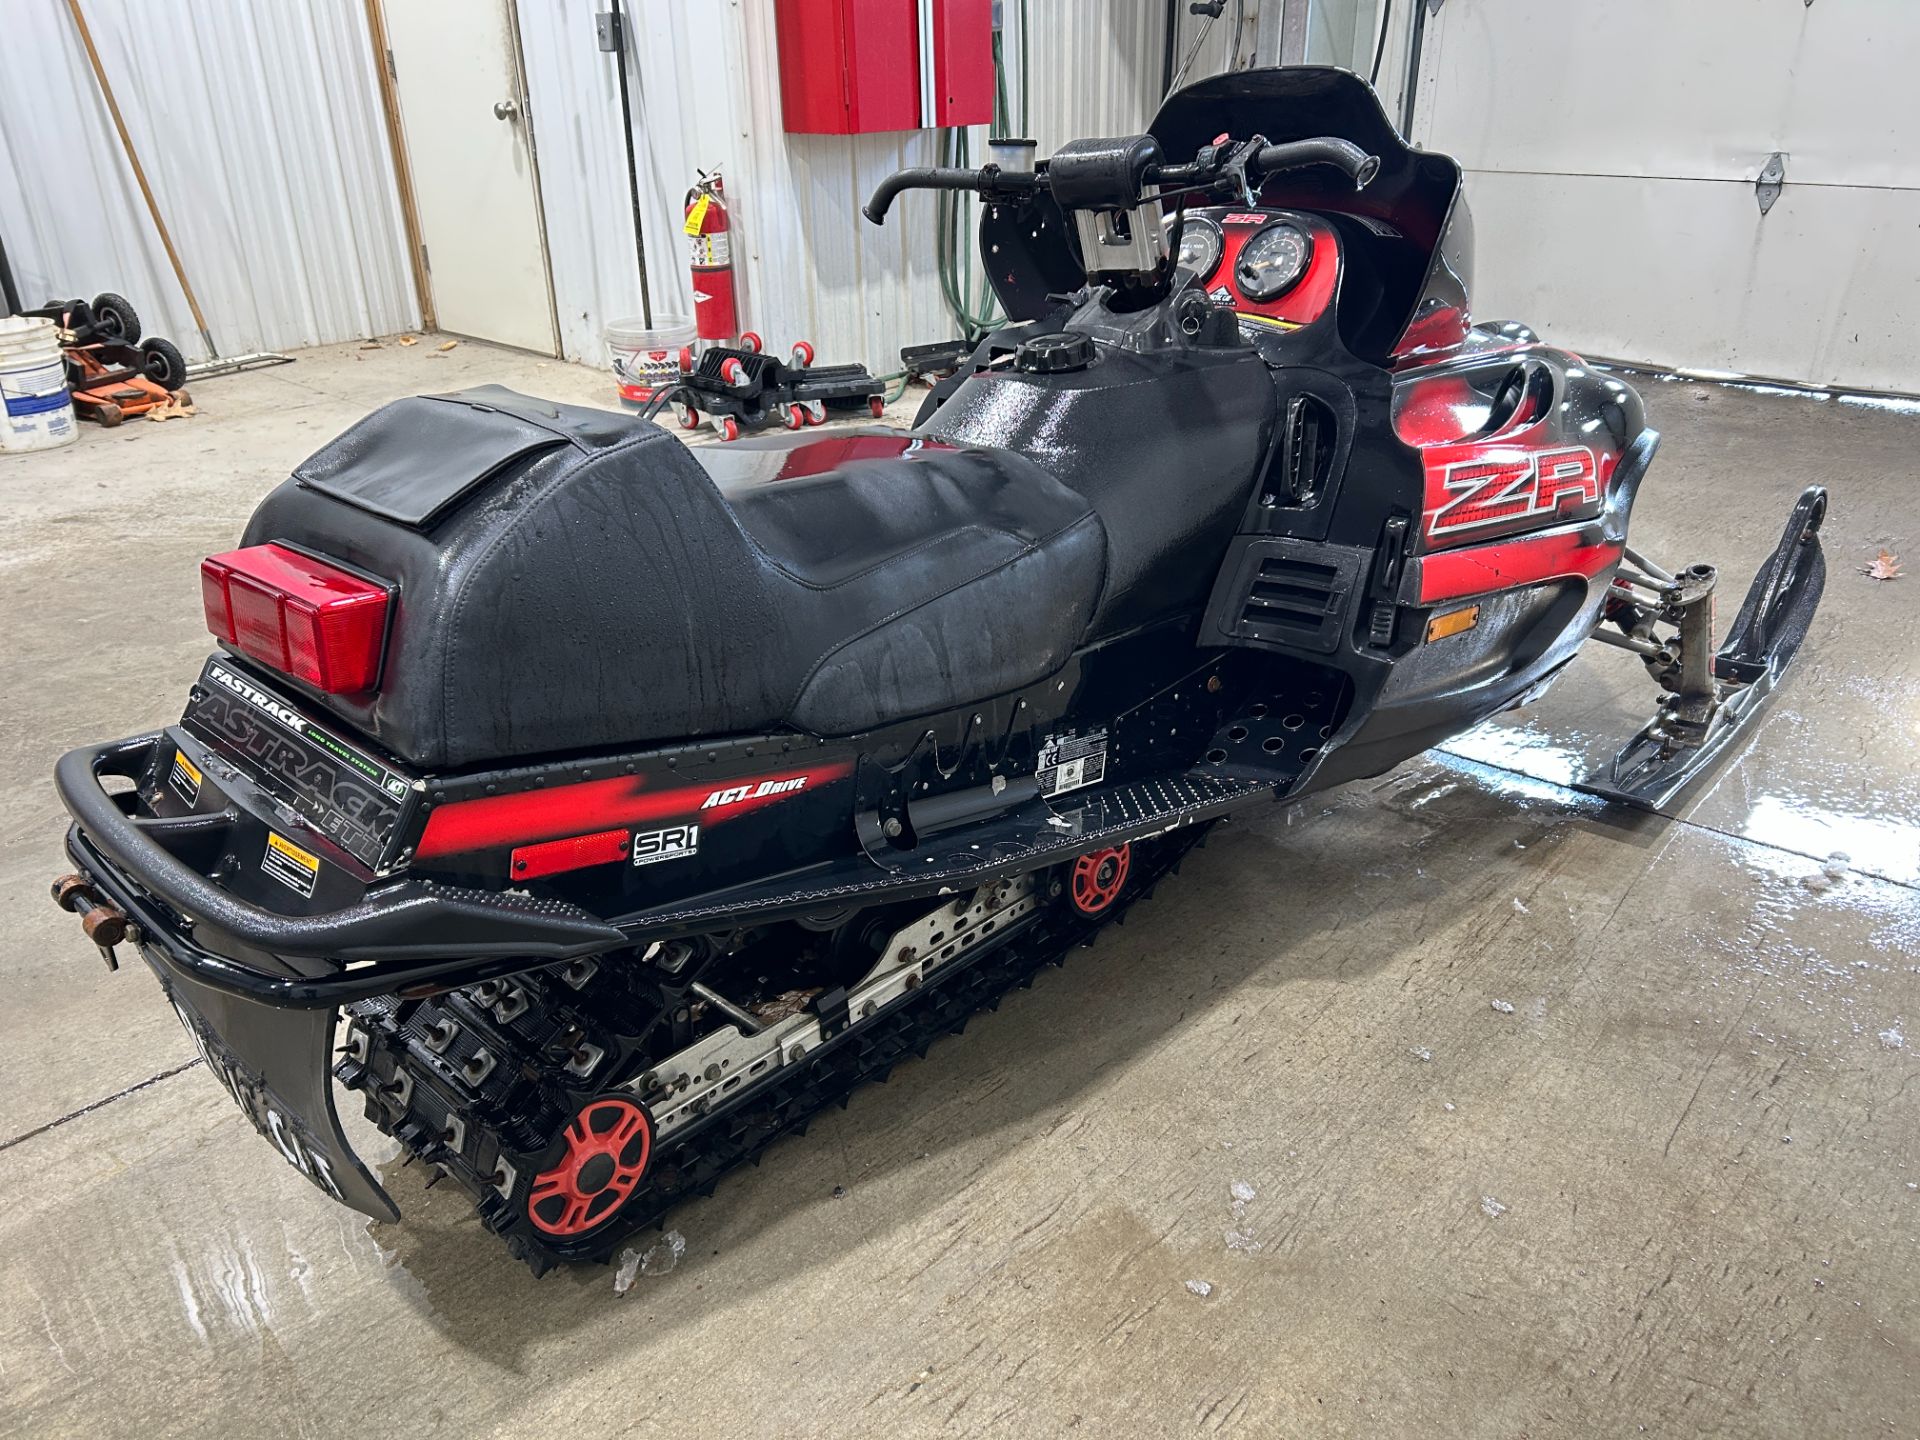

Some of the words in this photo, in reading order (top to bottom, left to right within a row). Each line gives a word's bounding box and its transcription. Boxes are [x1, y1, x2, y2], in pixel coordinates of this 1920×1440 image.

[1221, 213, 1268, 225] ZR
[1427, 445, 1599, 537] ZR
[210, 666, 307, 733] FASTRACK
[307, 729, 326, 743] LONG
[325, 740, 350, 759] TRAVEL
[350, 757, 378, 777] SYSTEM
[700, 784, 753, 810] ACT
[635, 825, 698, 857] SR1
